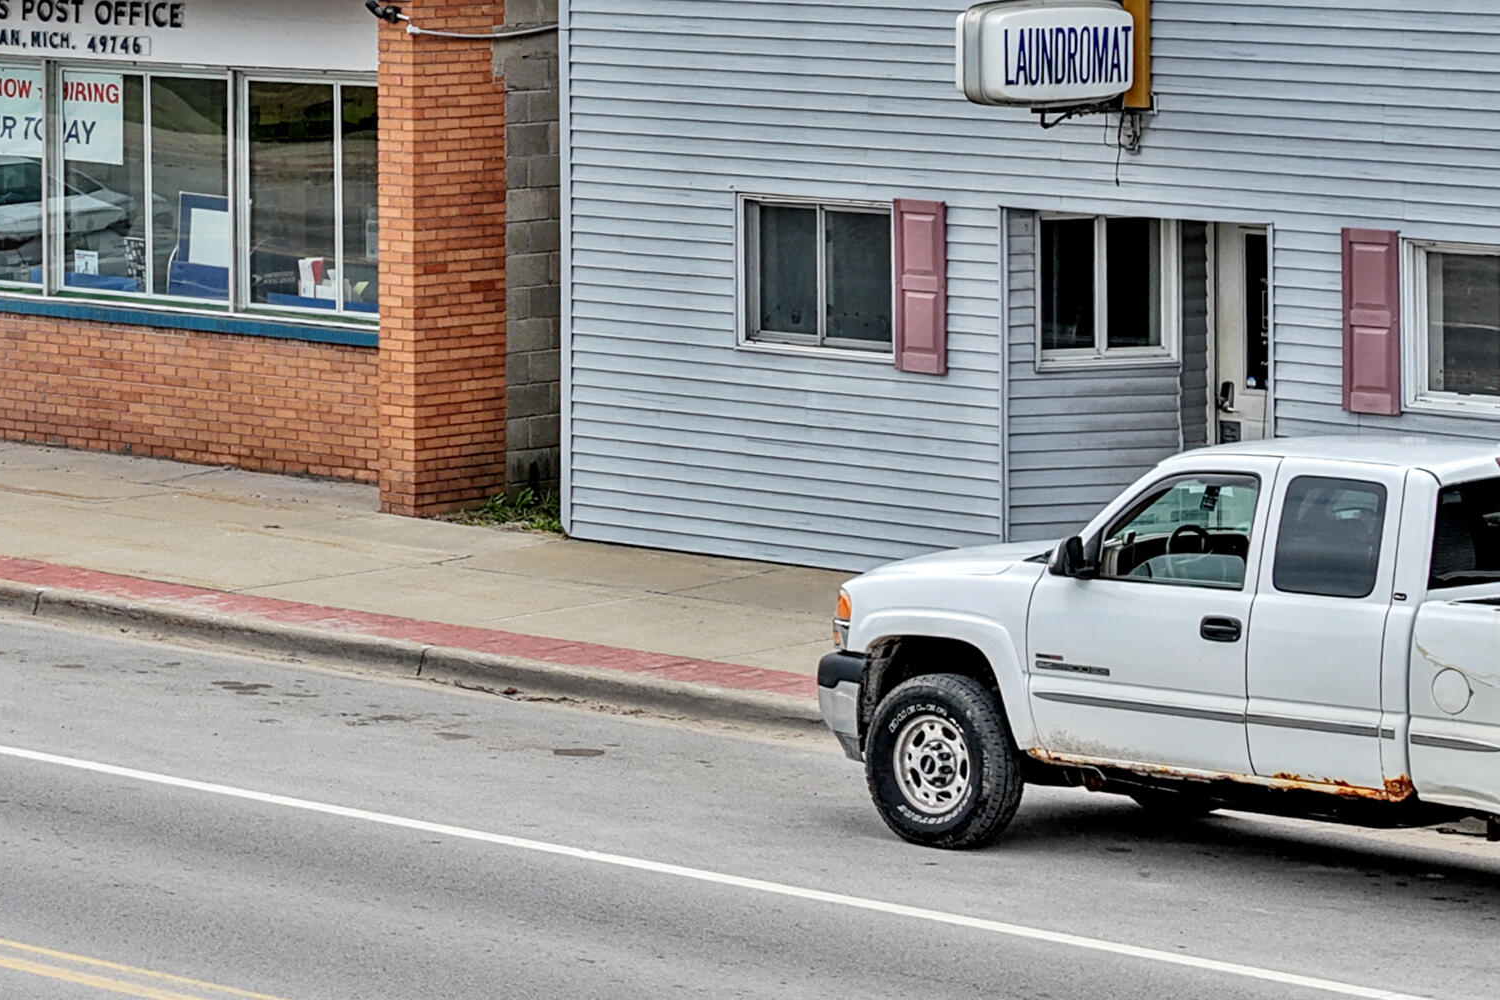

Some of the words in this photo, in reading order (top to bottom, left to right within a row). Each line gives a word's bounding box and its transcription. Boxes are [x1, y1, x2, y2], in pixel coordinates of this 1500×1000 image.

[94, 0, 185, 29] OFFICE
[31, 31, 76, 51] MICH.
[86, 35, 143, 56] 49746
[1004, 26, 1131, 86] LAUNDROMAT
[24, 116, 97, 145] TOAY
